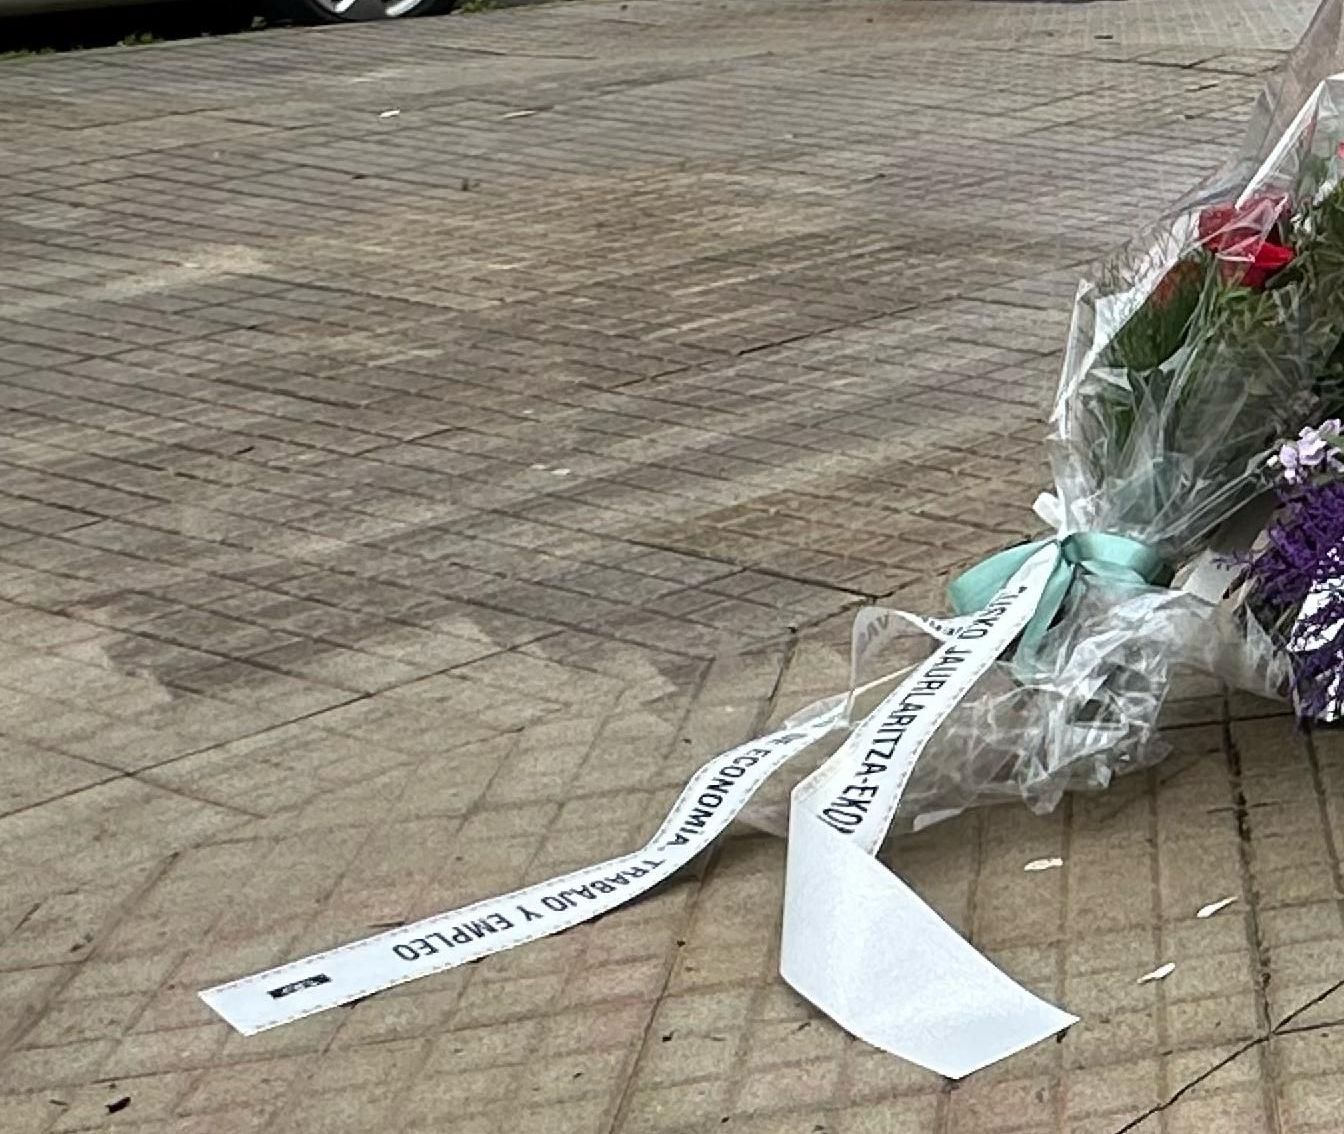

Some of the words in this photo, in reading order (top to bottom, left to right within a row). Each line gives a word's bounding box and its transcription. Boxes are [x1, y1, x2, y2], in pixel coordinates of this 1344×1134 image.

[542, 857, 667, 915] TRABAJO
[391, 911, 513, 964] EMPLEO
[515, 903, 542, 923] Y
